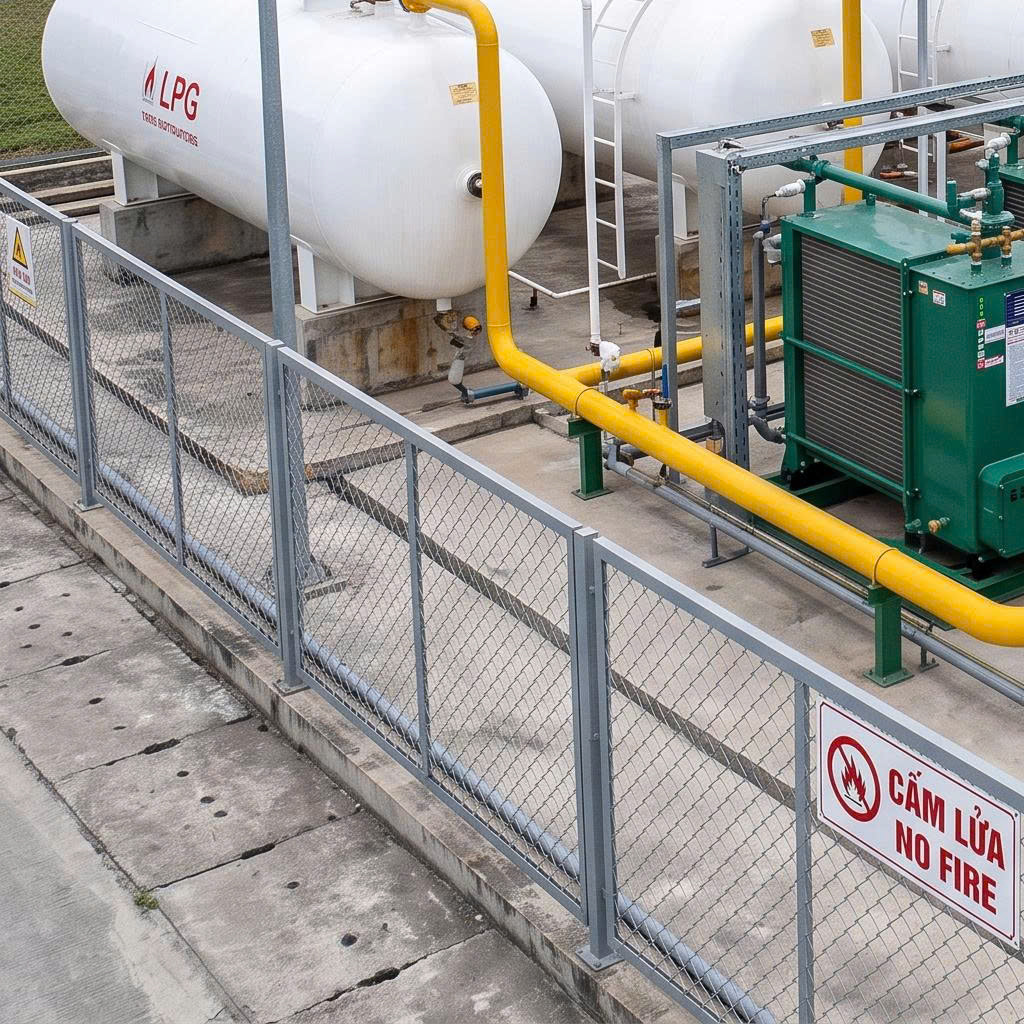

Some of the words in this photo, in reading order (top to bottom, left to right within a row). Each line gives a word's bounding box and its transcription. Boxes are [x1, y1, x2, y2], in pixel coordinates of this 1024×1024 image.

[160, 70, 200, 121] LPG
[896, 819, 930, 870] NO
[940, 847, 997, 915] FIRE
[955, 805, 1005, 871] LỬA
